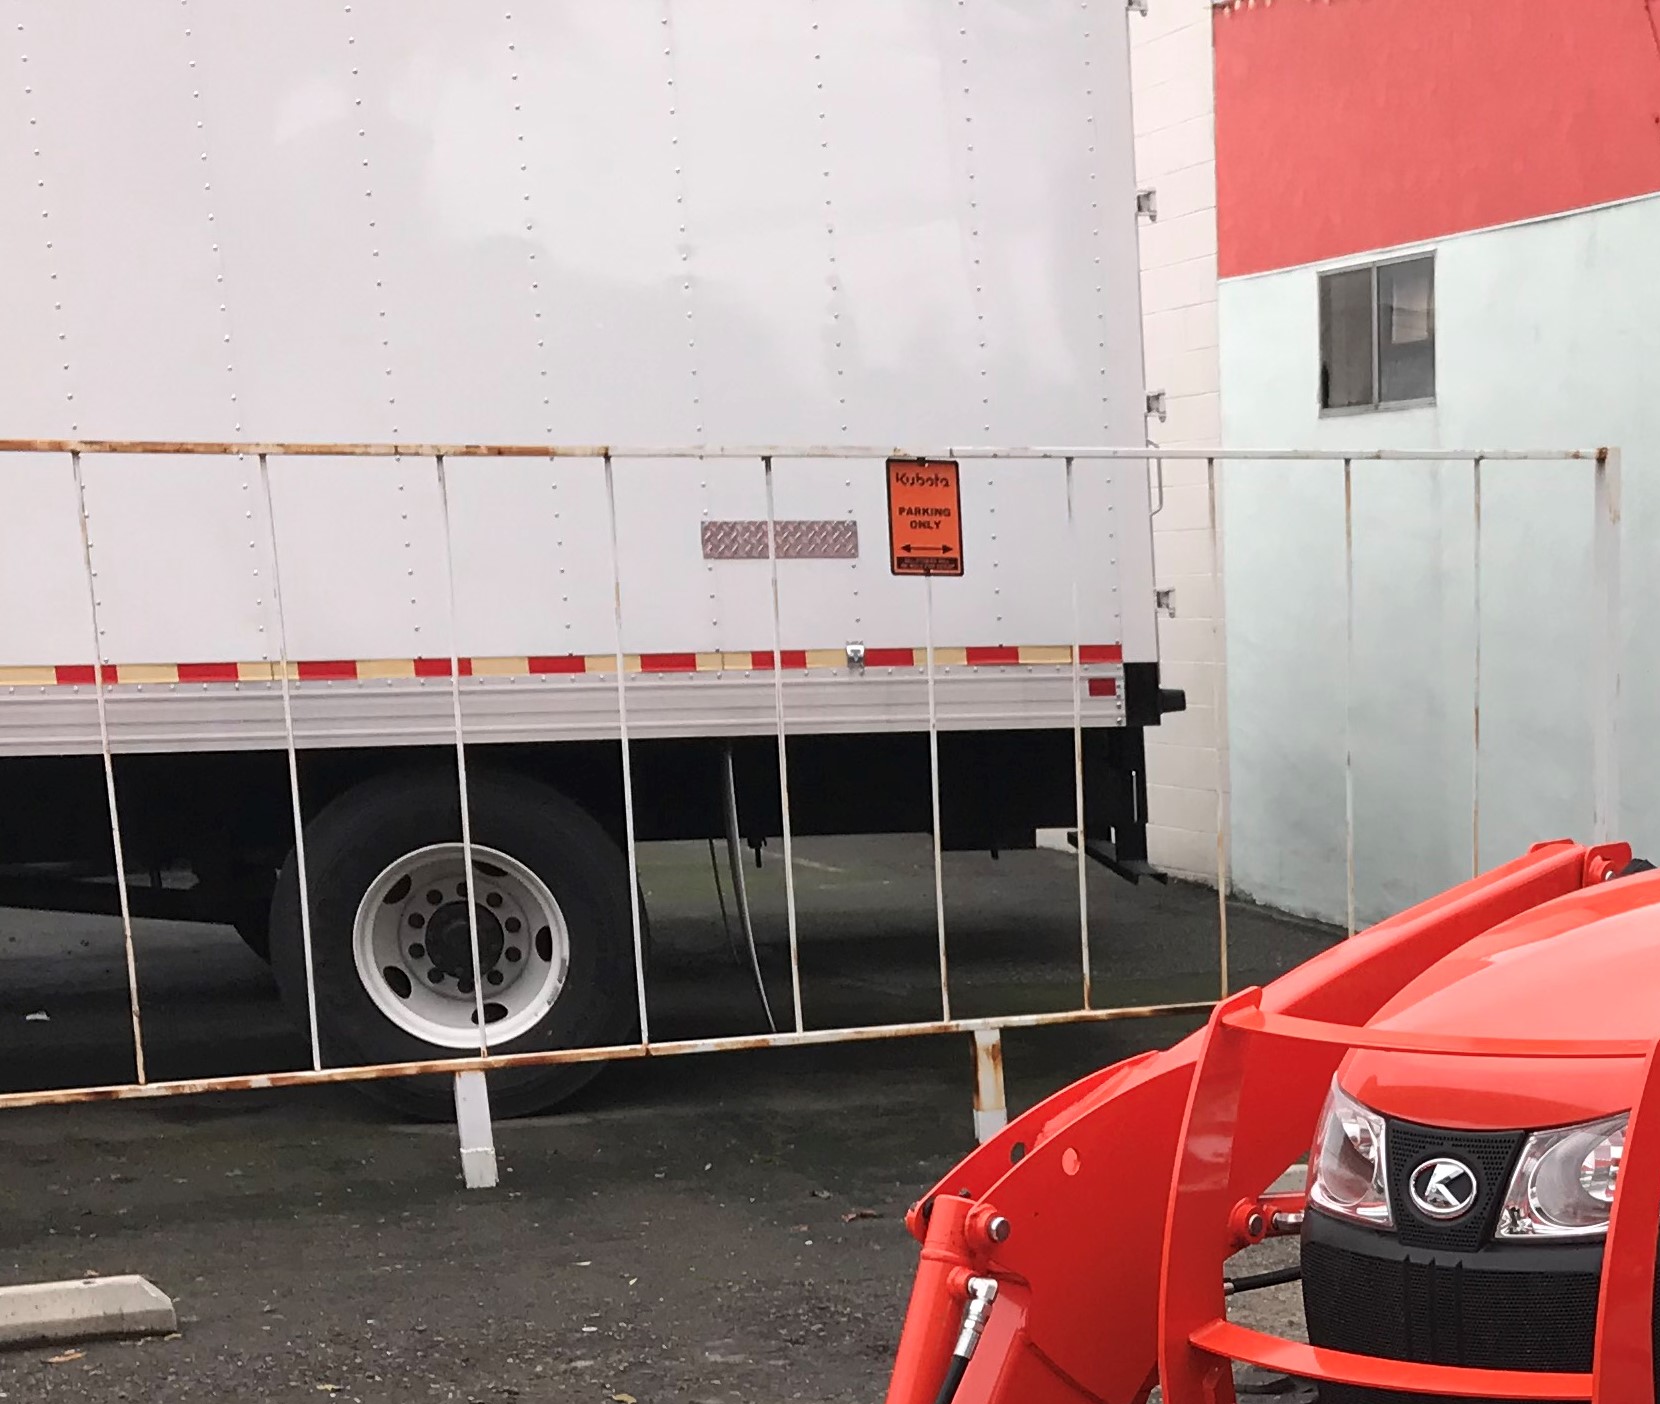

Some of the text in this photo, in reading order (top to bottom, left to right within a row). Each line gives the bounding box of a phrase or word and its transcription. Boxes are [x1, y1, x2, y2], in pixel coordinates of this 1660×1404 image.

[896, 472, 950, 487] Kubota
[898, 506, 951, 517] PARKING
[909, 520, 942, 530] ONLY
